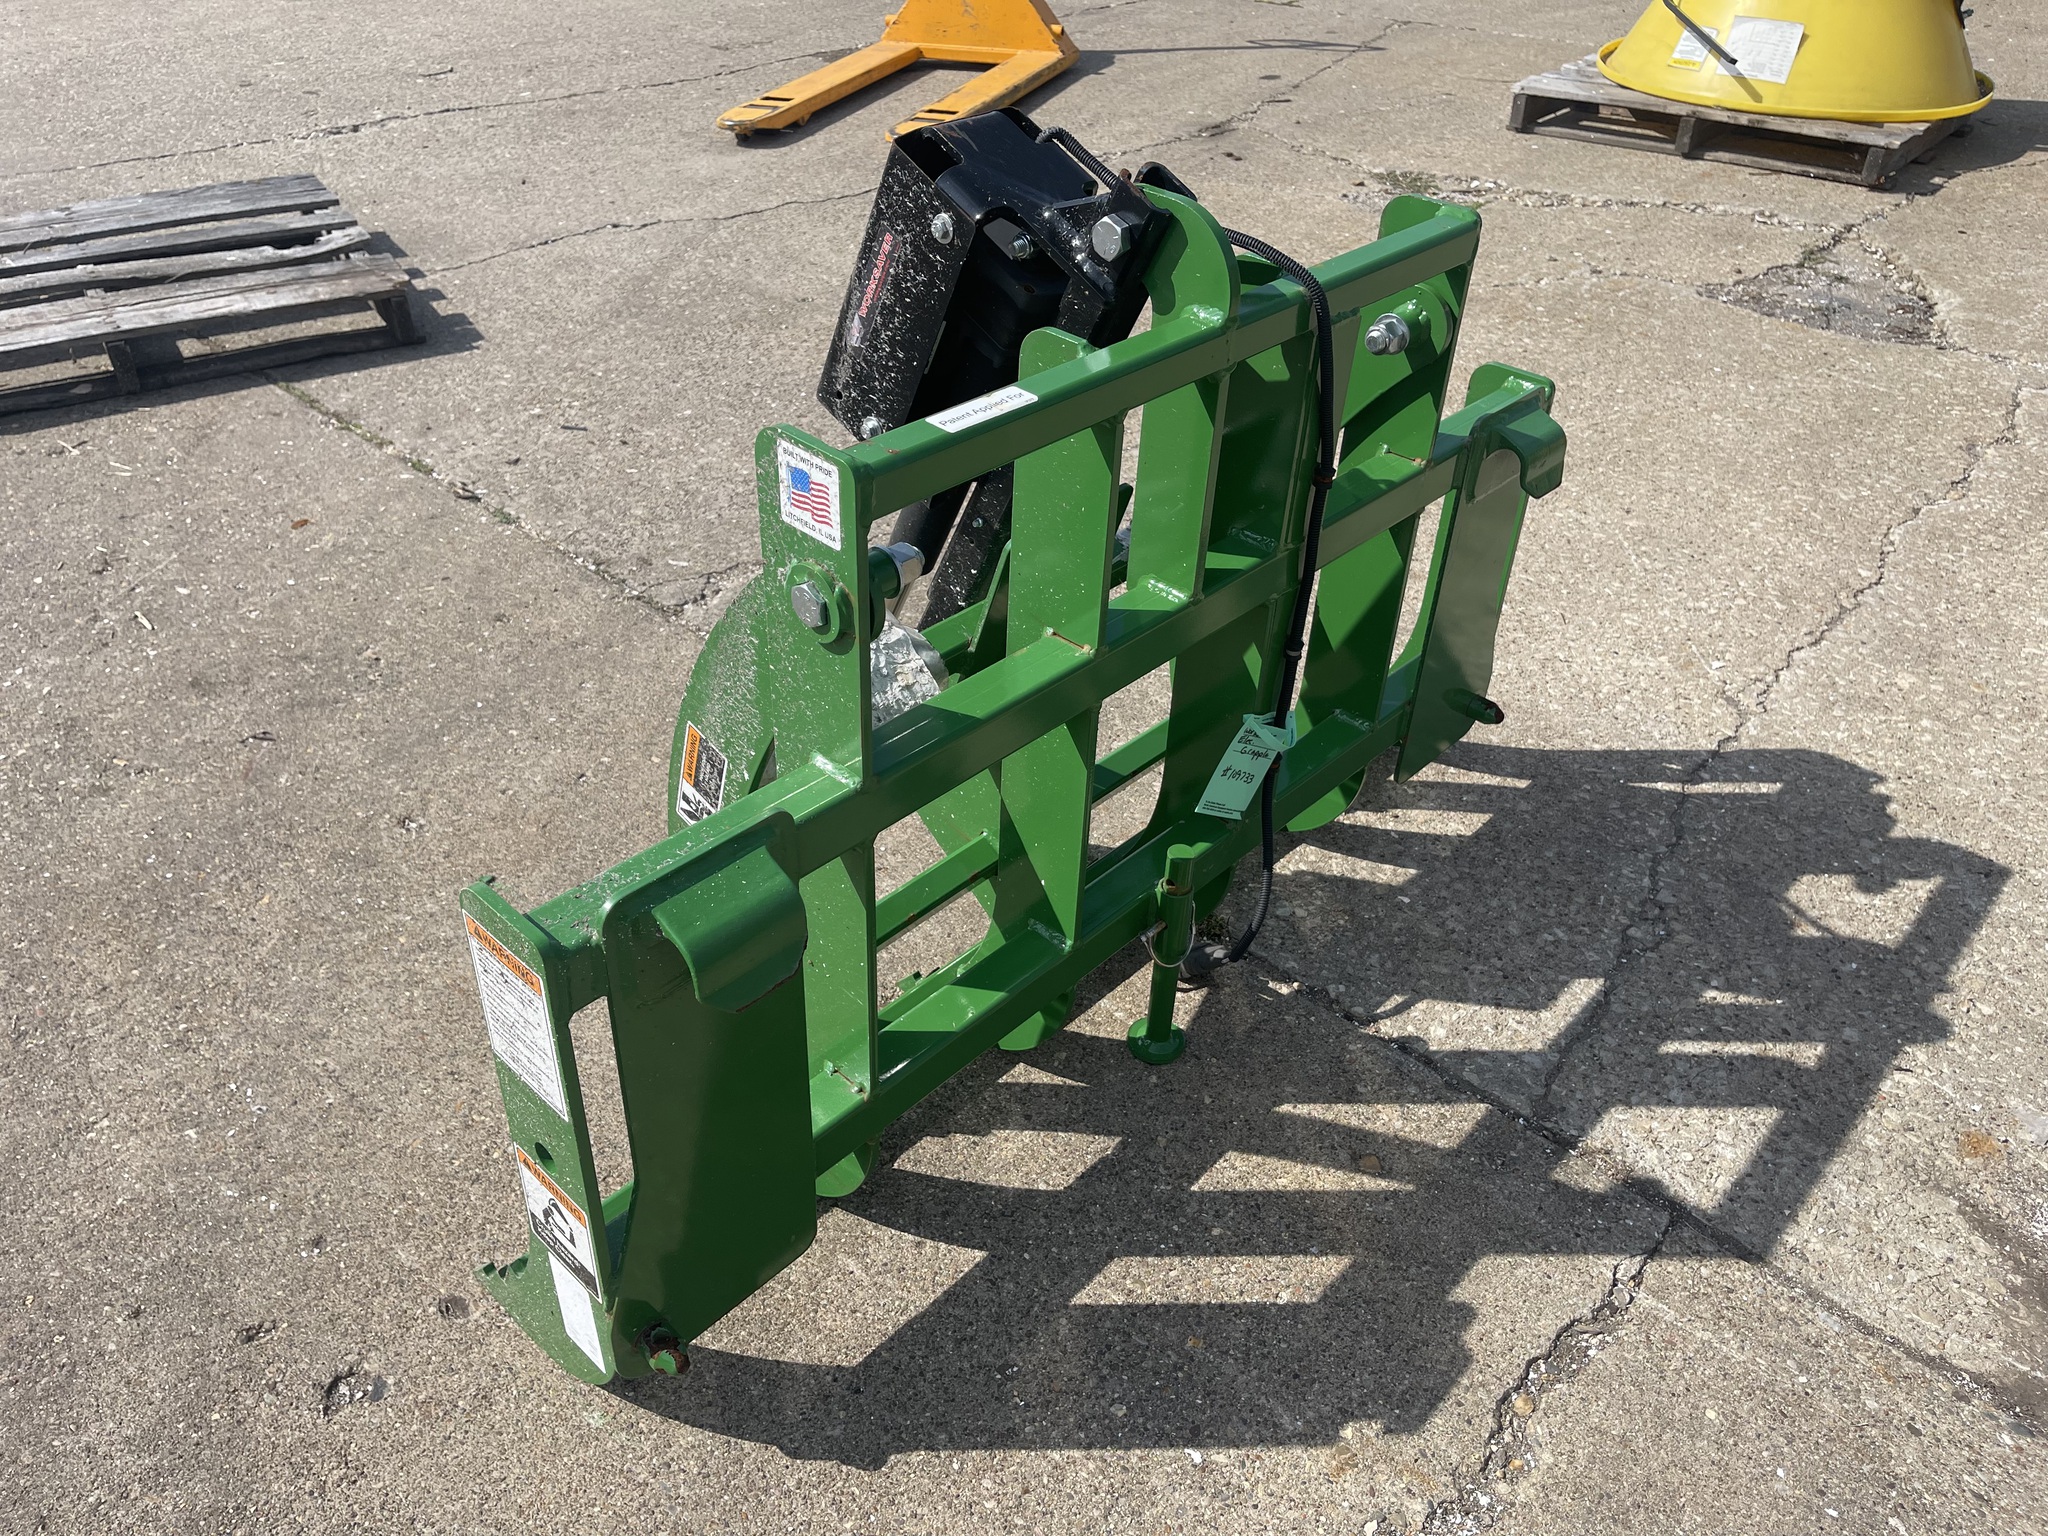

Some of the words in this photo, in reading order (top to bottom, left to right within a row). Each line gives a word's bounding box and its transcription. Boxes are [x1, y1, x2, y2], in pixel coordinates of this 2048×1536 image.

[858, 232, 893, 318] WORKSAVER
[939, 411, 974, 427] Patent
[973, 398, 1008, 414] Applied
[1006, 392, 1025, 401] For
[782, 447, 798, 460] BUILT
[799, 455, 814, 469] WITH
[814, 463, 832, 478] PRIDE
[818, 527, 824, 537] IL
[824, 531, 837, 543] USA
[687, 734, 698, 772] WARNING
[1221, 765, 1254, 784] #109733
[483, 935, 535, 986] WARNING
[532, 1166, 583, 1222] WARNING
